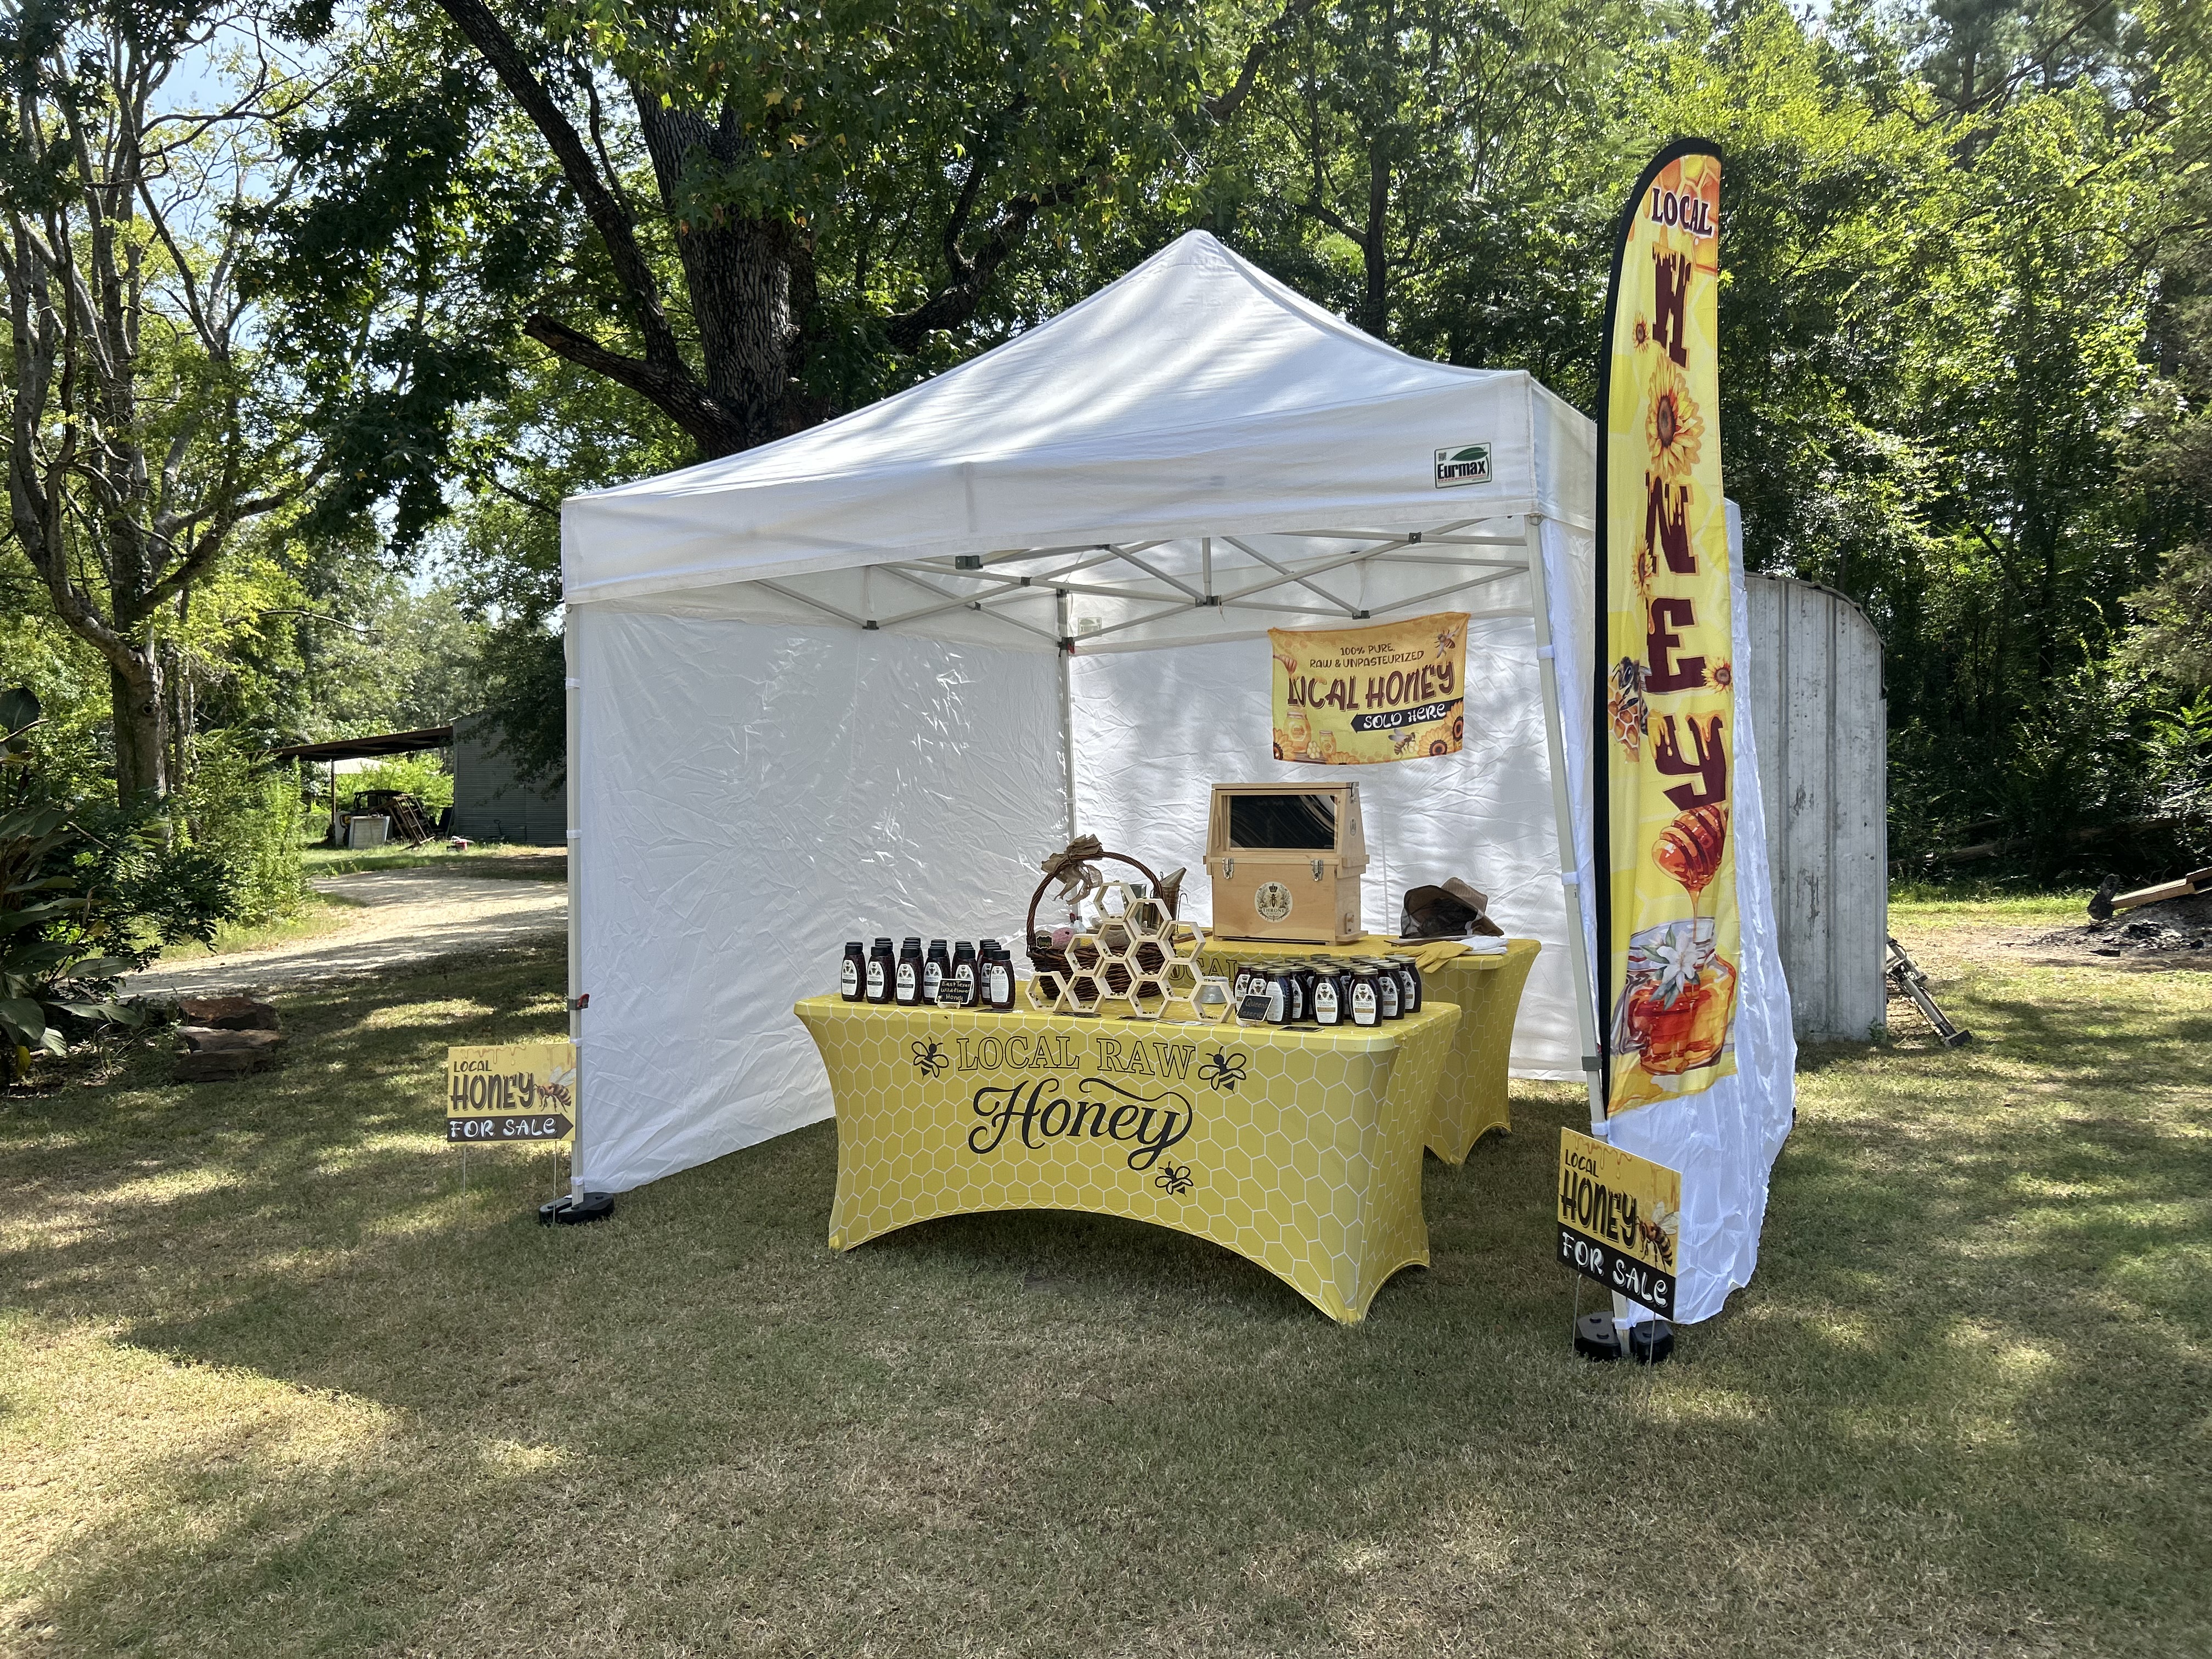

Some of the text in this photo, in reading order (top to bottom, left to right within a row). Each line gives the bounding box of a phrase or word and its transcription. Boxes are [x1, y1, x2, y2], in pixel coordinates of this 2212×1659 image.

[1651, 187, 1713, 237] LOCAL
[1437, 461, 1486, 480] Eurmax
[1645, 247, 1729, 812] HNEY
[1310, 659, 1332, 668] RAW
[1342, 651, 1425, 668] UNPASTEURIZED
[1340, 643, 1396, 656] 100% PURE,
[1365, 661, 1455, 709] HONEY
[1363, 704, 1447, 729] SOLD HERE
[946, 994, 963, 1003] Honey
[454, 1060, 493, 1073] LOCAL
[956, 1035, 1196, 1080] LOCAL RAW
[450, 1071, 536, 1111] HONEY
[450, 1118, 557, 1138] FOR SALE
[968, 1077, 1193, 1171] Honey
[1565, 1149, 1599, 1178] LOCAL
[1560, 1167, 1638, 1249] HONEY
[1562, 1232, 1668, 1308] FOR SALE
